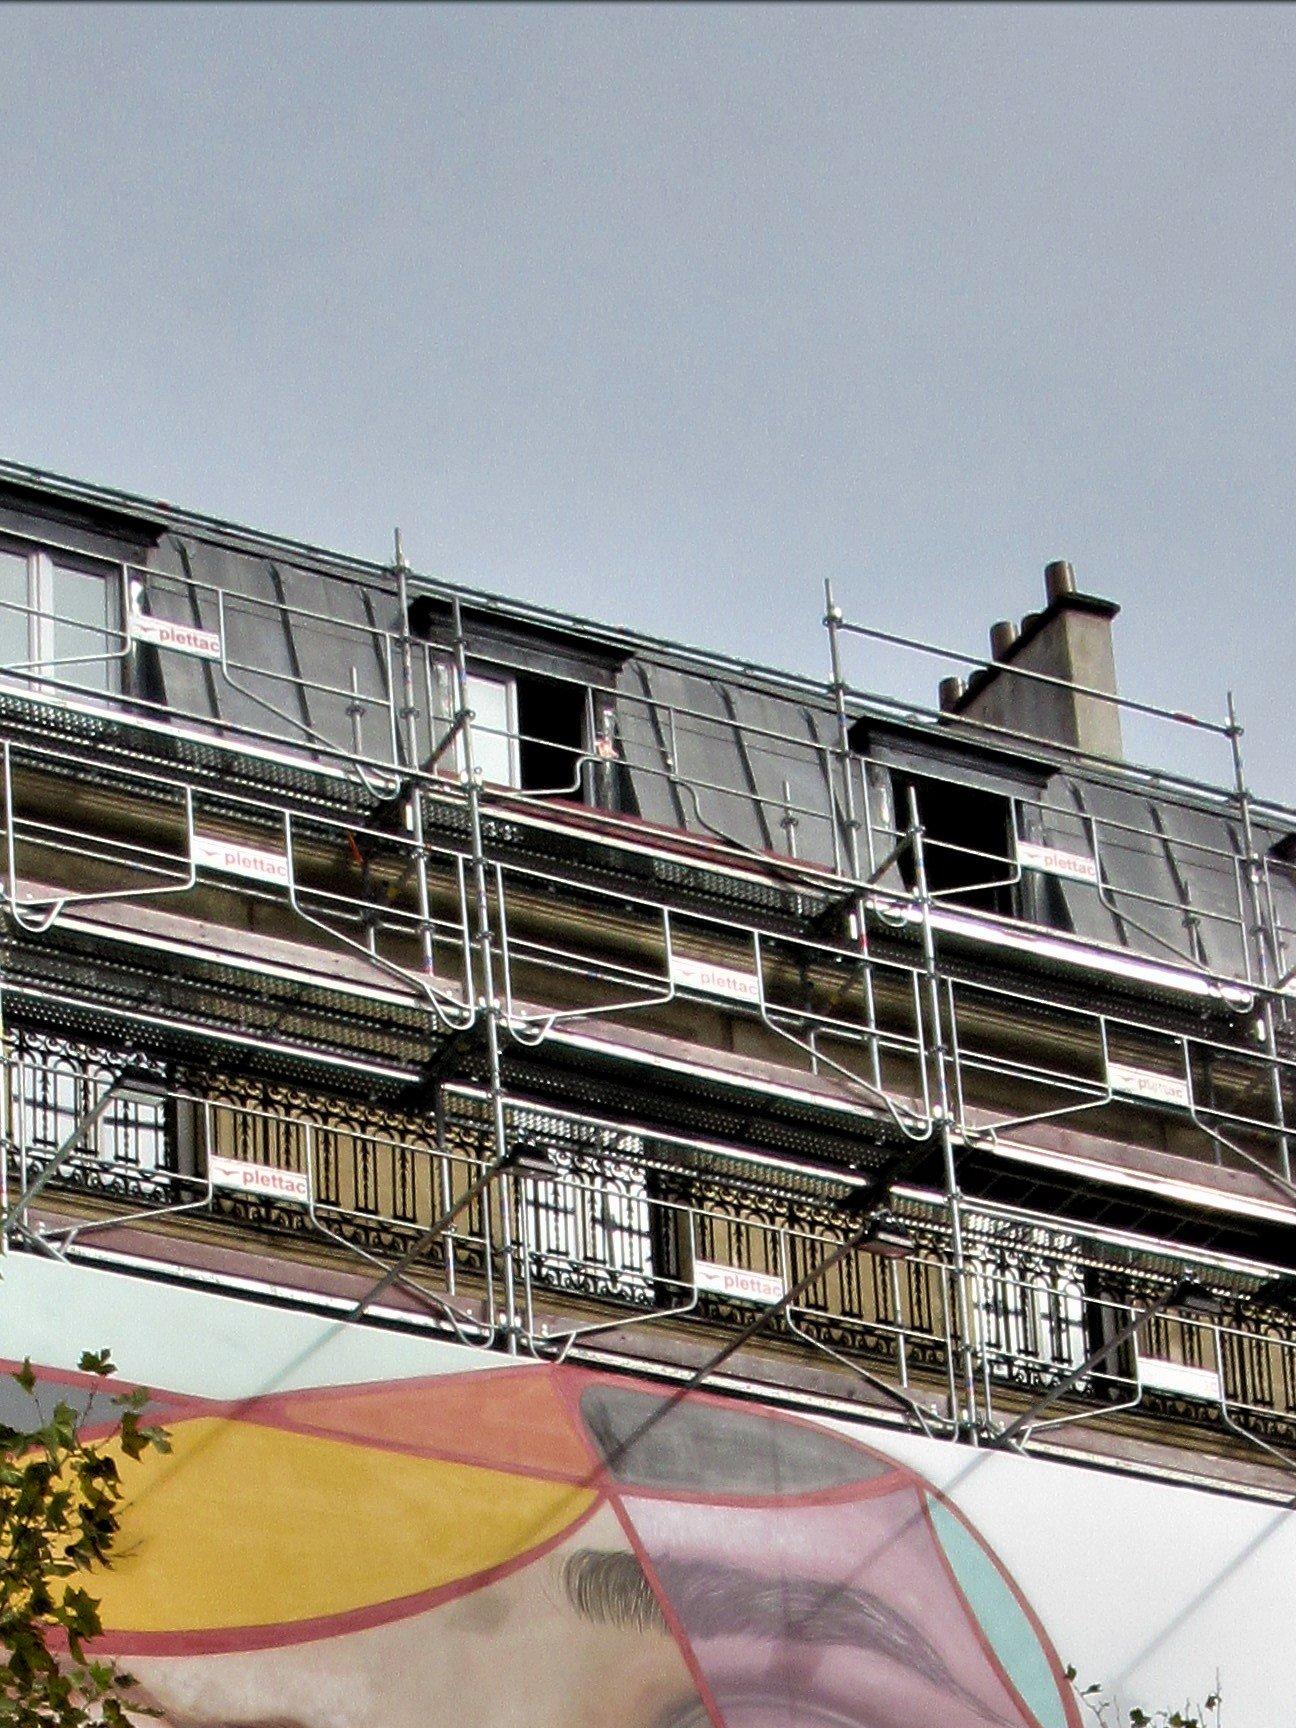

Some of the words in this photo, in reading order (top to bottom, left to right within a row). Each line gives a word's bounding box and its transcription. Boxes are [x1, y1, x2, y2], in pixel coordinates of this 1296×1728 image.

[158, 627, 220, 654] plettac
[224, 850, 290, 877] plettac
[1044, 853, 1096, 876] plettac
[700, 969, 759, 996] plettac
[242, 1169, 307, 1195] plettac
[724, 1275, 783, 1297] plettac
